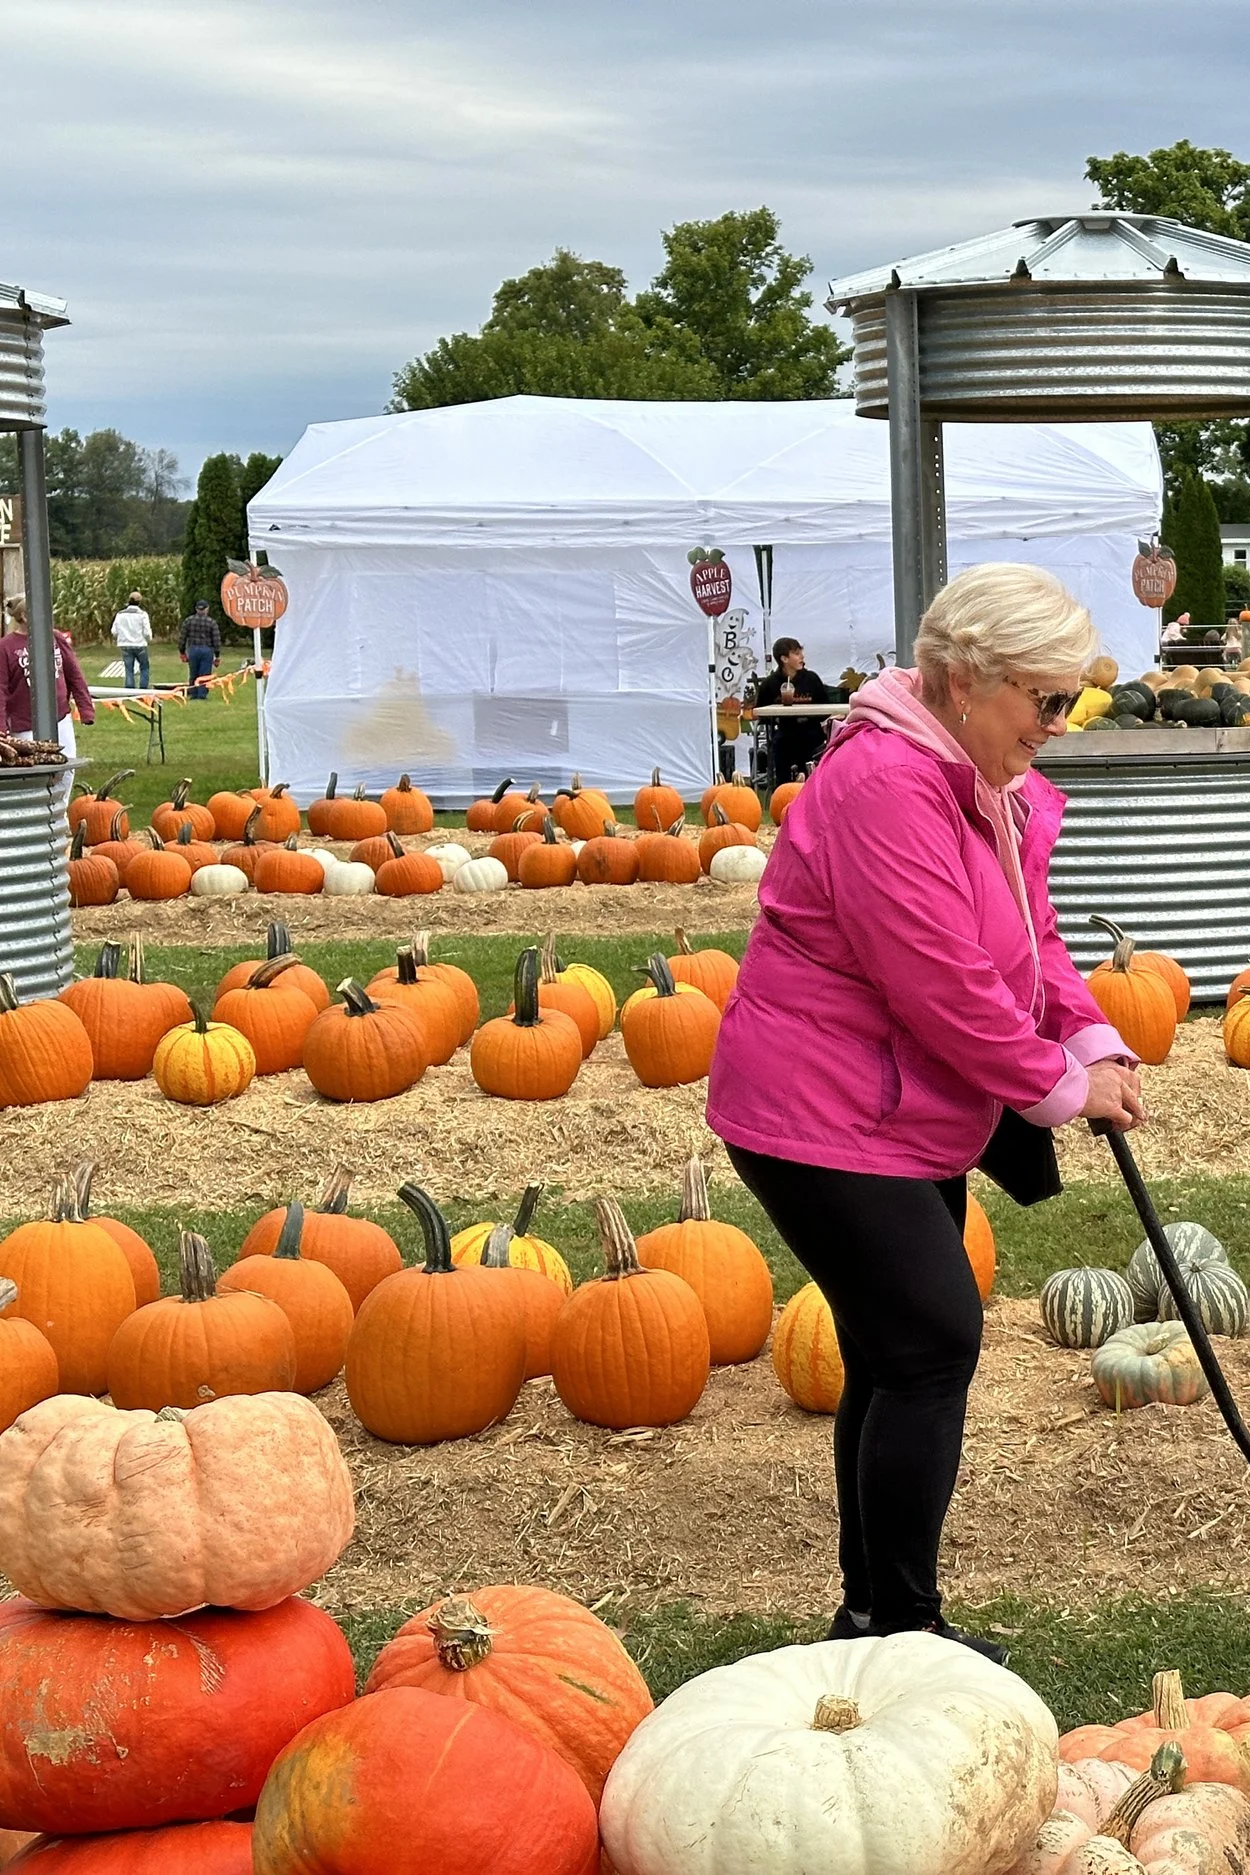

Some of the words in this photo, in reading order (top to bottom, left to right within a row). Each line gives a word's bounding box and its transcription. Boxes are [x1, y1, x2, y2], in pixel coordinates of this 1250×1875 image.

[696, 565, 727, 584] APPLE
[1135, 564, 1175, 582] PUMPKIN
[227, 583, 283, 601] PUMPKIN
[696, 579, 730, 598] HARVEST
[1141, 579, 1165, 593] PATCH
[237, 597, 273, 613] PATCH
